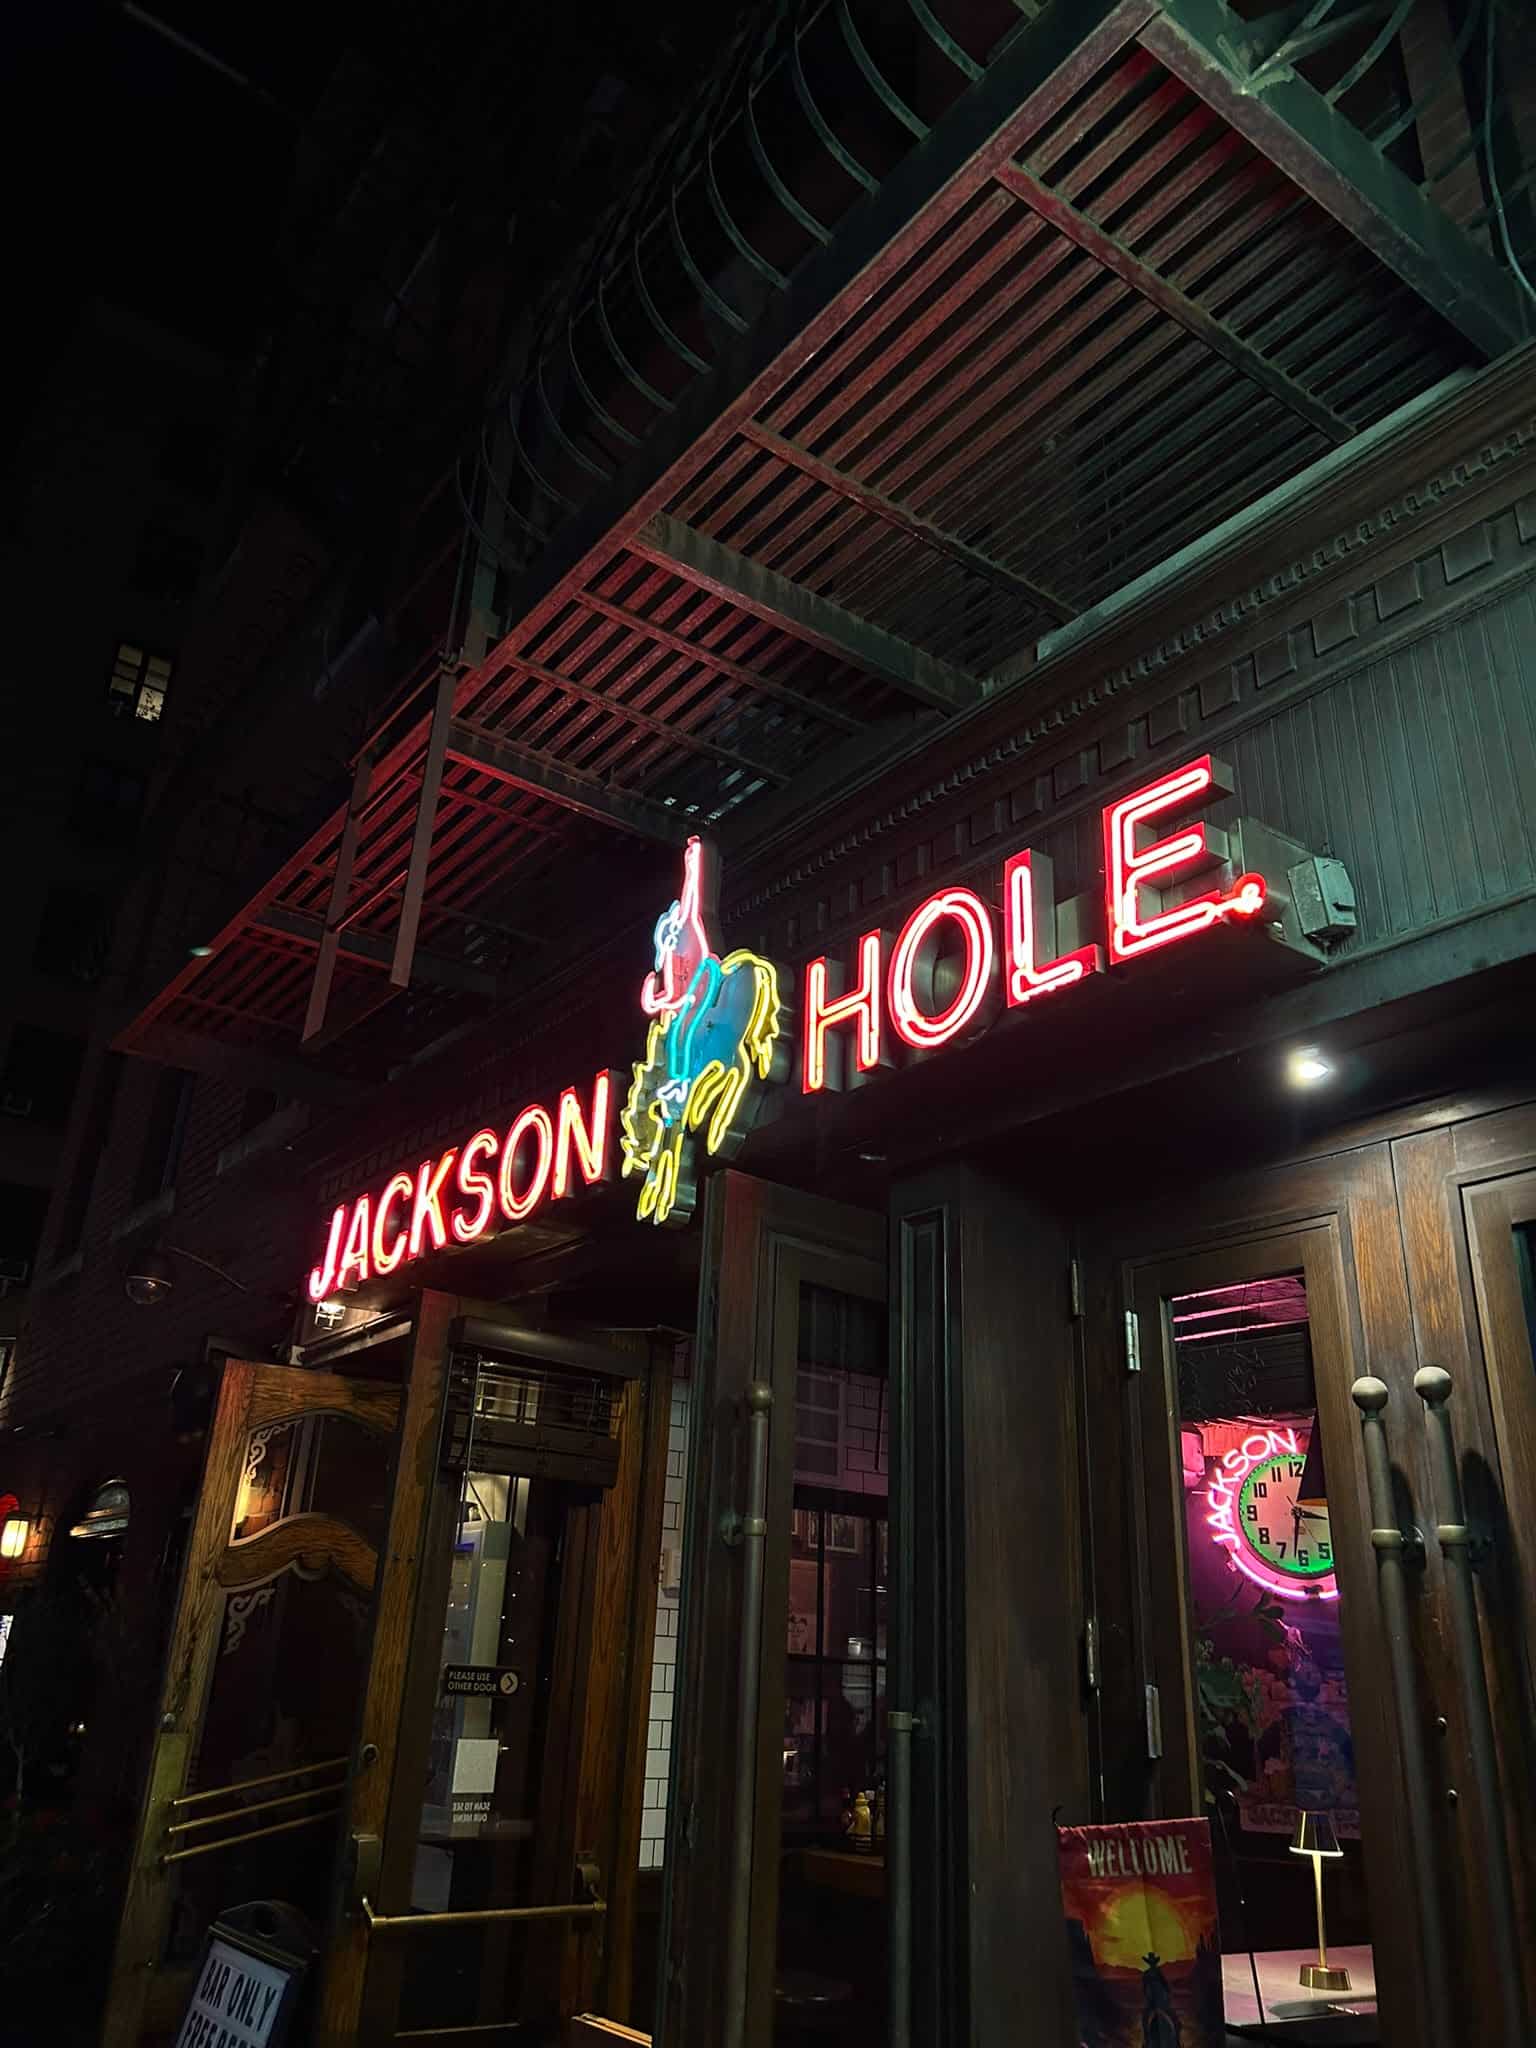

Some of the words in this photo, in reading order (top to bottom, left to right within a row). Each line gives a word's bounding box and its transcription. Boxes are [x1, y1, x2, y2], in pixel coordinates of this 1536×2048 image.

[309, 1068, 609, 1302] JACKSON
[1272, 1467, 1282, 1482] 11
[1288, 1461, 1303, 1477] 12
[1207, 1428, 1299, 1550] JACKSON
[1254, 1483, 1267, 1498] 10
[1247, 1505, 1258, 1521] 9
[1259, 1528, 1270, 1544] 8
[1276, 1542, 1287, 1559] 7
[1298, 1550, 1309, 1566] 6
[1318, 1543, 1331, 1559] 5
[448, 1671, 476, 1681] PLEASE
[477, 1672, 491, 1682] USE
[448, 1681, 473, 1691] OTHER
[473, 1682, 497, 1692] DOOR
[1087, 1835, 1192, 1877] WELCOME
[201, 1959, 230, 2009] BAR
[227, 1973, 277, 2032] ONLY
